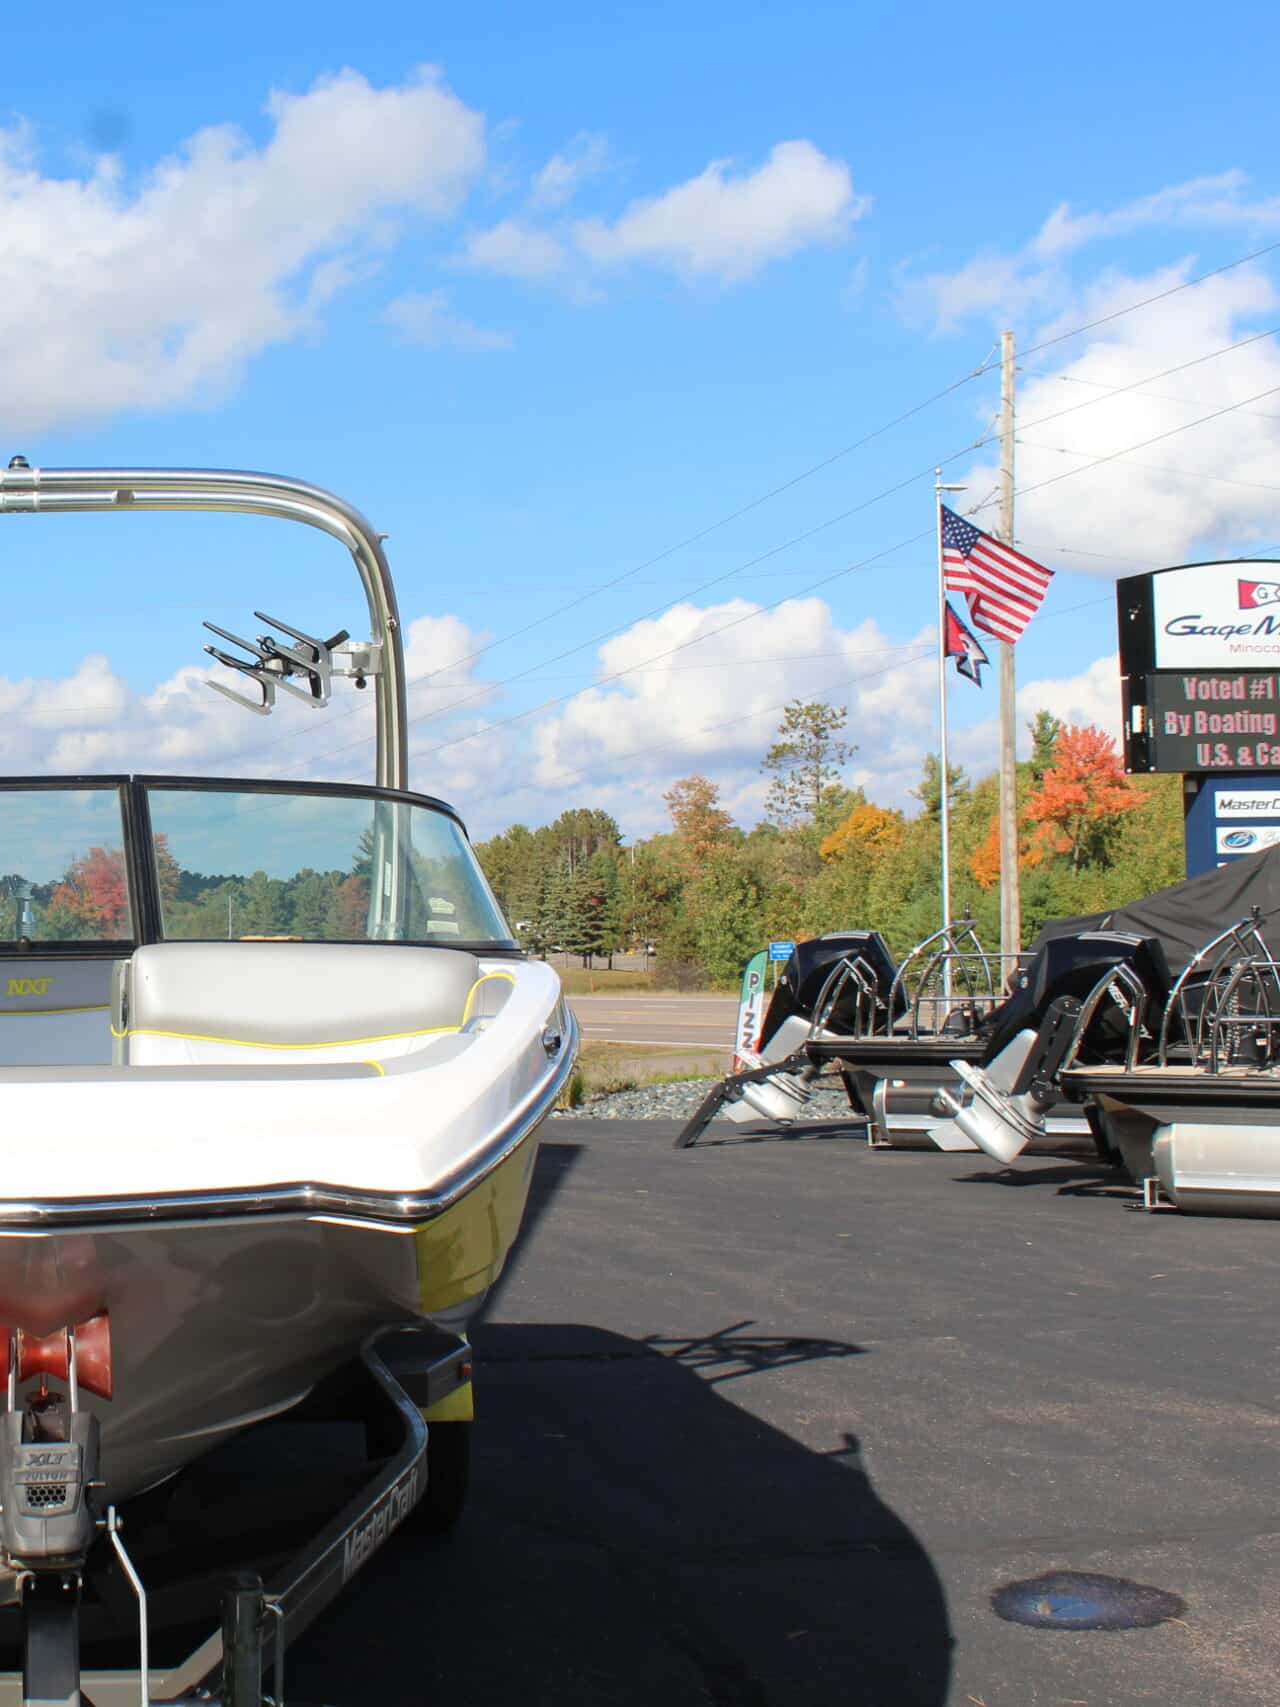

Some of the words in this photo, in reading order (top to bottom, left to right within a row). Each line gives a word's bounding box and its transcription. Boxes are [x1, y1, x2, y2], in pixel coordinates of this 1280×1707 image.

[1183, 676, 1246, 700] Voted
[1249, 676, 1274, 699] #1
[1164, 712, 1192, 736] By
[1194, 710, 1276, 735] Boating
[1197, 743, 1234, 766] U.S.
[1237, 746, 1254, 766] &
[742, 972, 760, 1049] PIZZ
[1107, 982, 1153, 1039] MERCY
[342, 1467, 418, 1584] MasterCraft
